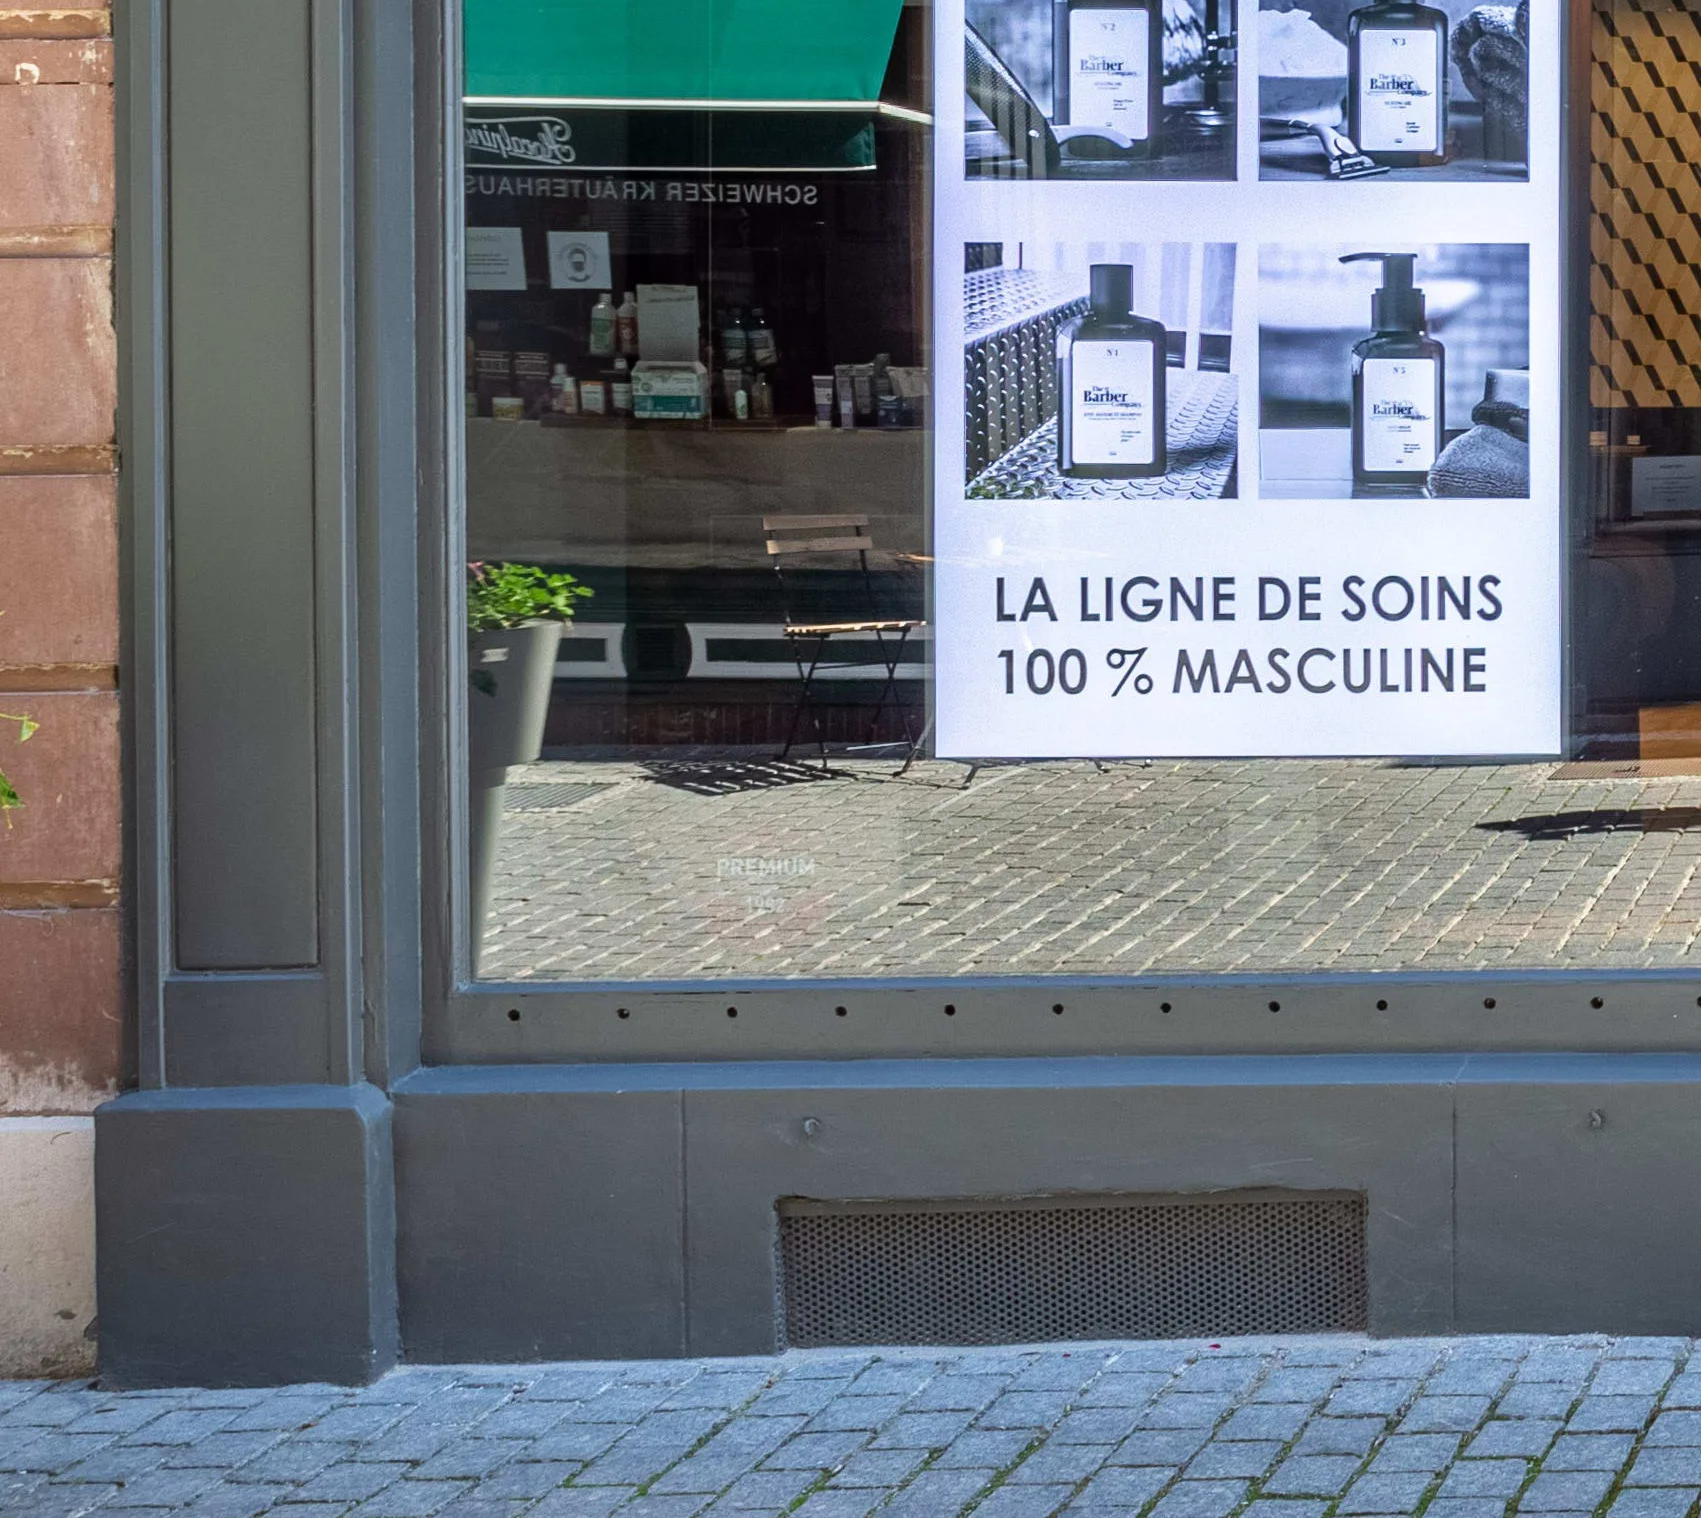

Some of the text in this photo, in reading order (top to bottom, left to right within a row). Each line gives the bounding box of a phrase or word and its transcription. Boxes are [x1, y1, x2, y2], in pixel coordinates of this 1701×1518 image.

[1370, 78, 1413, 89] Barber
[1084, 390, 1128, 402] Barber
[996, 574, 1503, 623] LA LIGNE DE SOINS
[997, 646, 1487, 697] 100 % MASCULINE
[717, 858, 815, 876] PREMIUM
